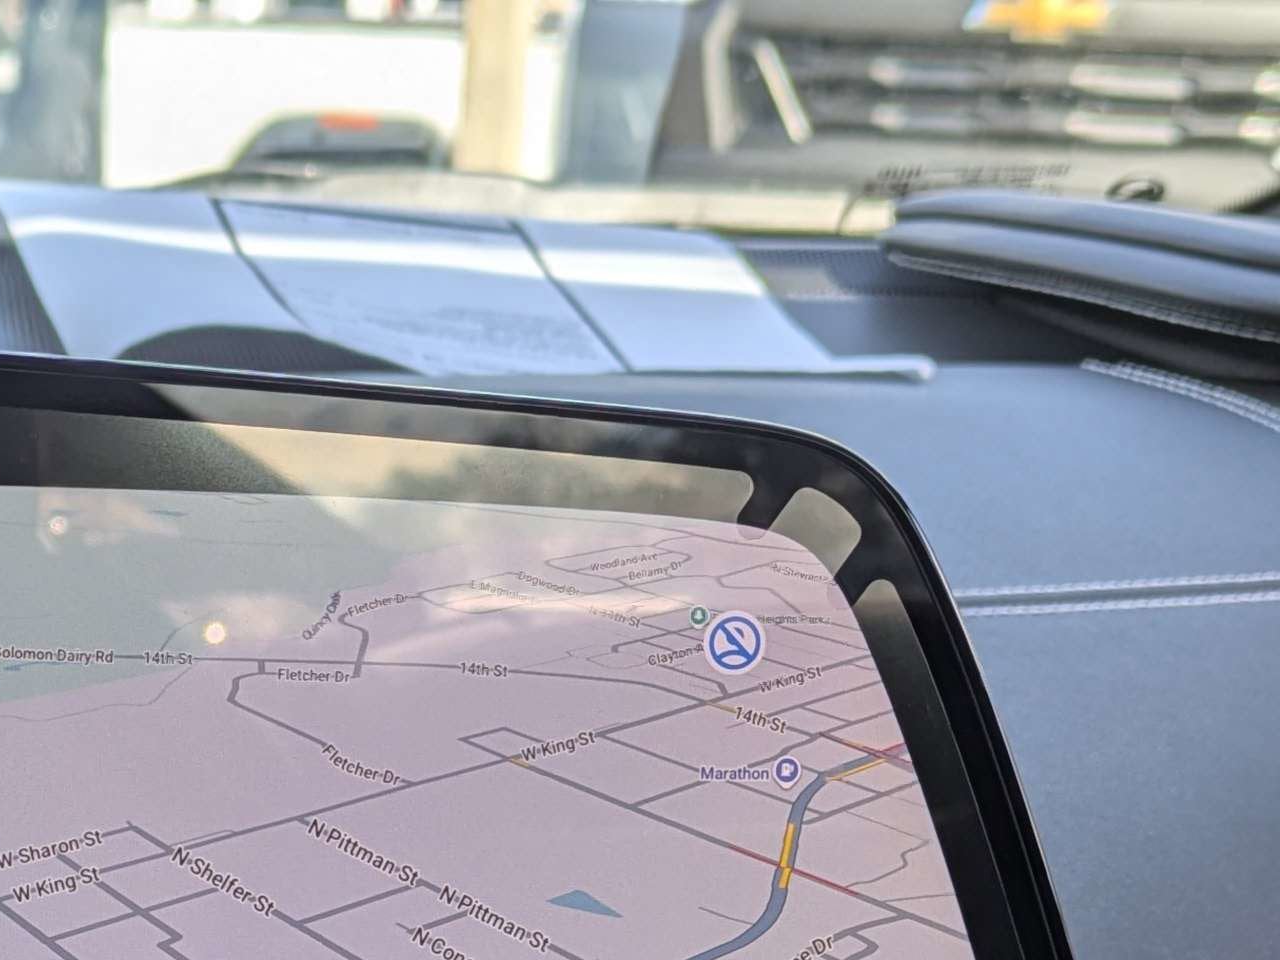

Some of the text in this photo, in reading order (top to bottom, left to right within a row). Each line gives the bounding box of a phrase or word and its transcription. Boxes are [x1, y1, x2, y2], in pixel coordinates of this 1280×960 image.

[347, 598, 392, 617] Fletcher
[57, 649, 91, 665] Dairy
[96, 651, 113, 663] Rd
[144, 652, 193, 665] 14th St
[277, 669, 351, 682] Fletcher Dr
[460, 662, 508, 677] 14th St
[776, 673, 804, 689] King
[805, 667, 821, 679] St
[736, 707, 787, 733] 14th St
[521, 731, 595, 761] W King St
[323, 744, 401, 785] Fletcher Dr
[700, 767, 769, 781] Marathon
[18, 838, 80, 864] Sharon
[83, 830, 102, 846] St
[308, 818, 419, 886] N Pittman St
[13, 867, 100, 902] W King St
[172, 847, 275, 917] N Shelfer St
[440, 885, 550, 952] N Pittman St
[412, 927, 430, 947] N
[812, 934, 834, 957] Dr
